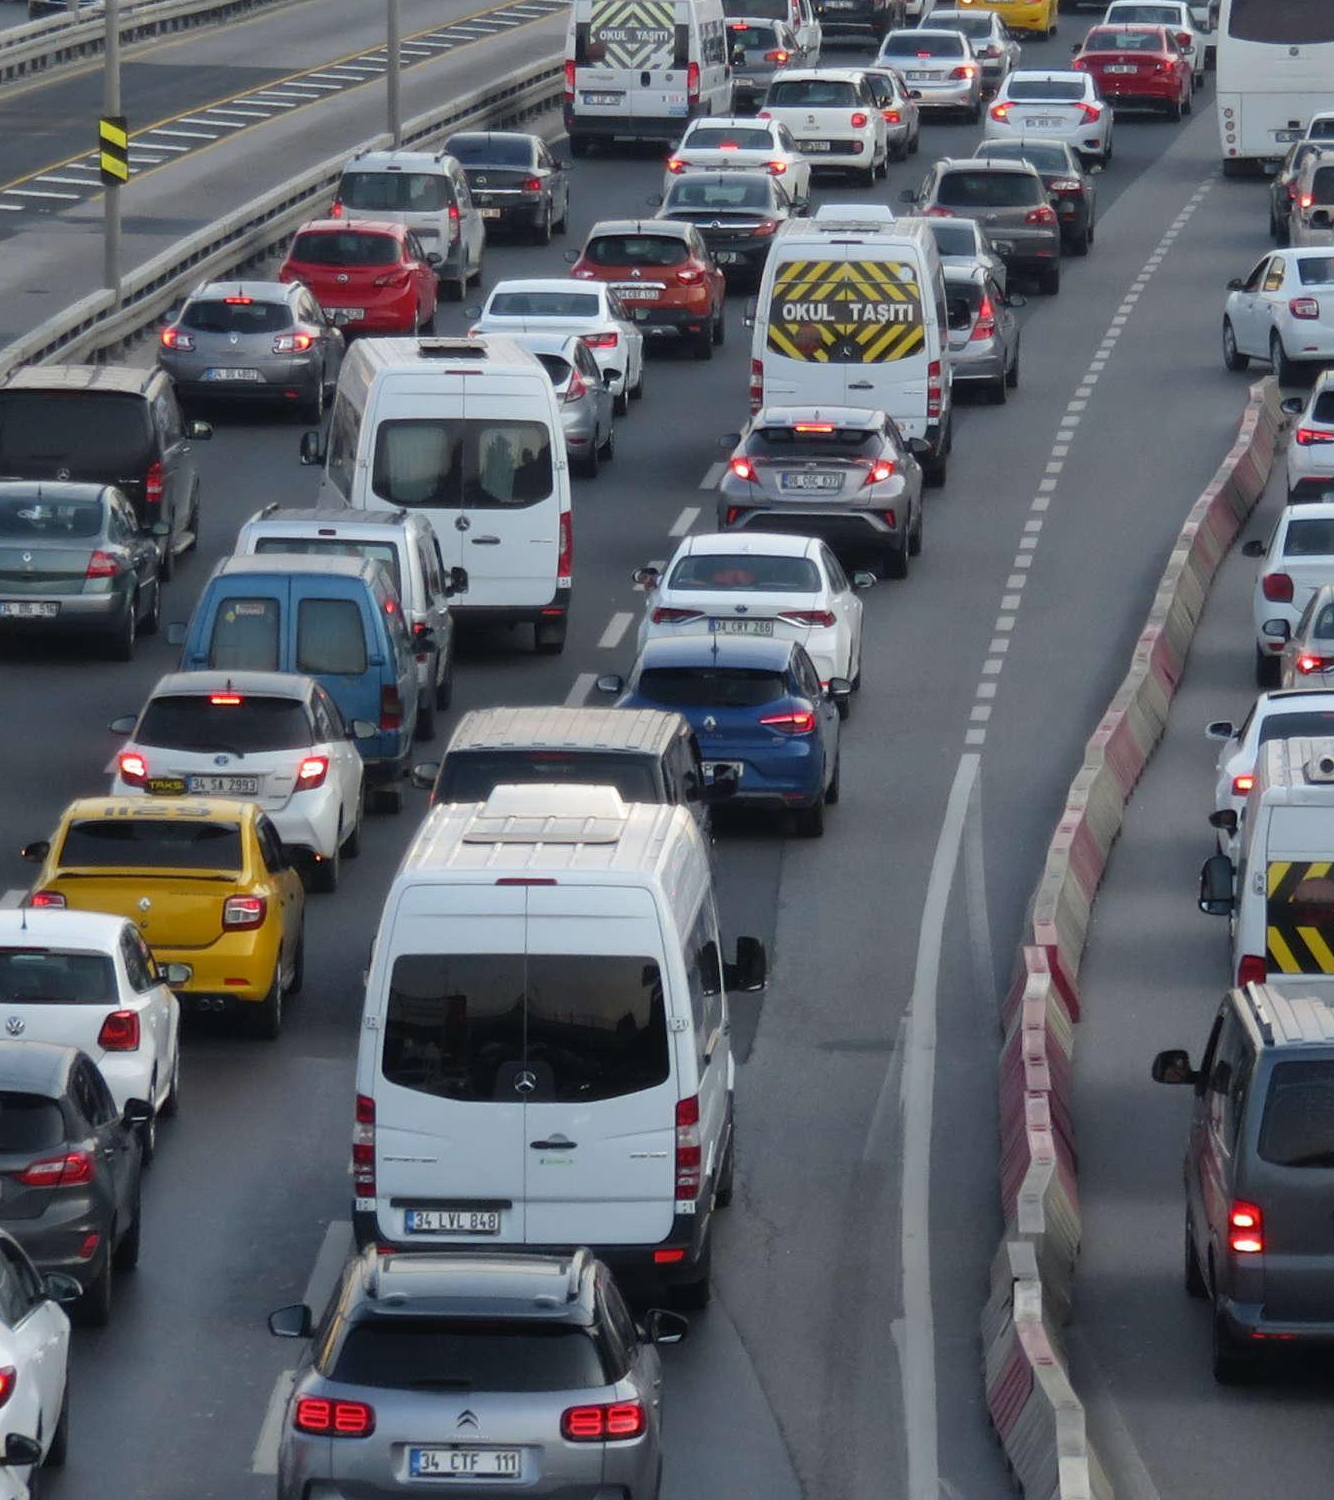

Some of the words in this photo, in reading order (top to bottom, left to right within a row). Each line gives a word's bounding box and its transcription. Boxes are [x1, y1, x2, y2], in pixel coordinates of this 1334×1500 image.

[599, 30, 627, 41] OKUL
[635, 30, 669, 42] TAŞITI
[782, 303, 835, 321] OKUL
[849, 303, 914, 323] TAŞITI
[192, 779, 205, 791] 34
[211, 779, 224, 791] SA
[229, 778, 256, 792] 2993
[416, 1211, 432, 1228] 34
[438, 1211, 464, 1229] LVL
[470, 1211, 497, 1230] 848
[421, 1452, 439, 1471] 34
[449, 1452, 479, 1471] CTF
[495, 1453, 517, 1472] 111
